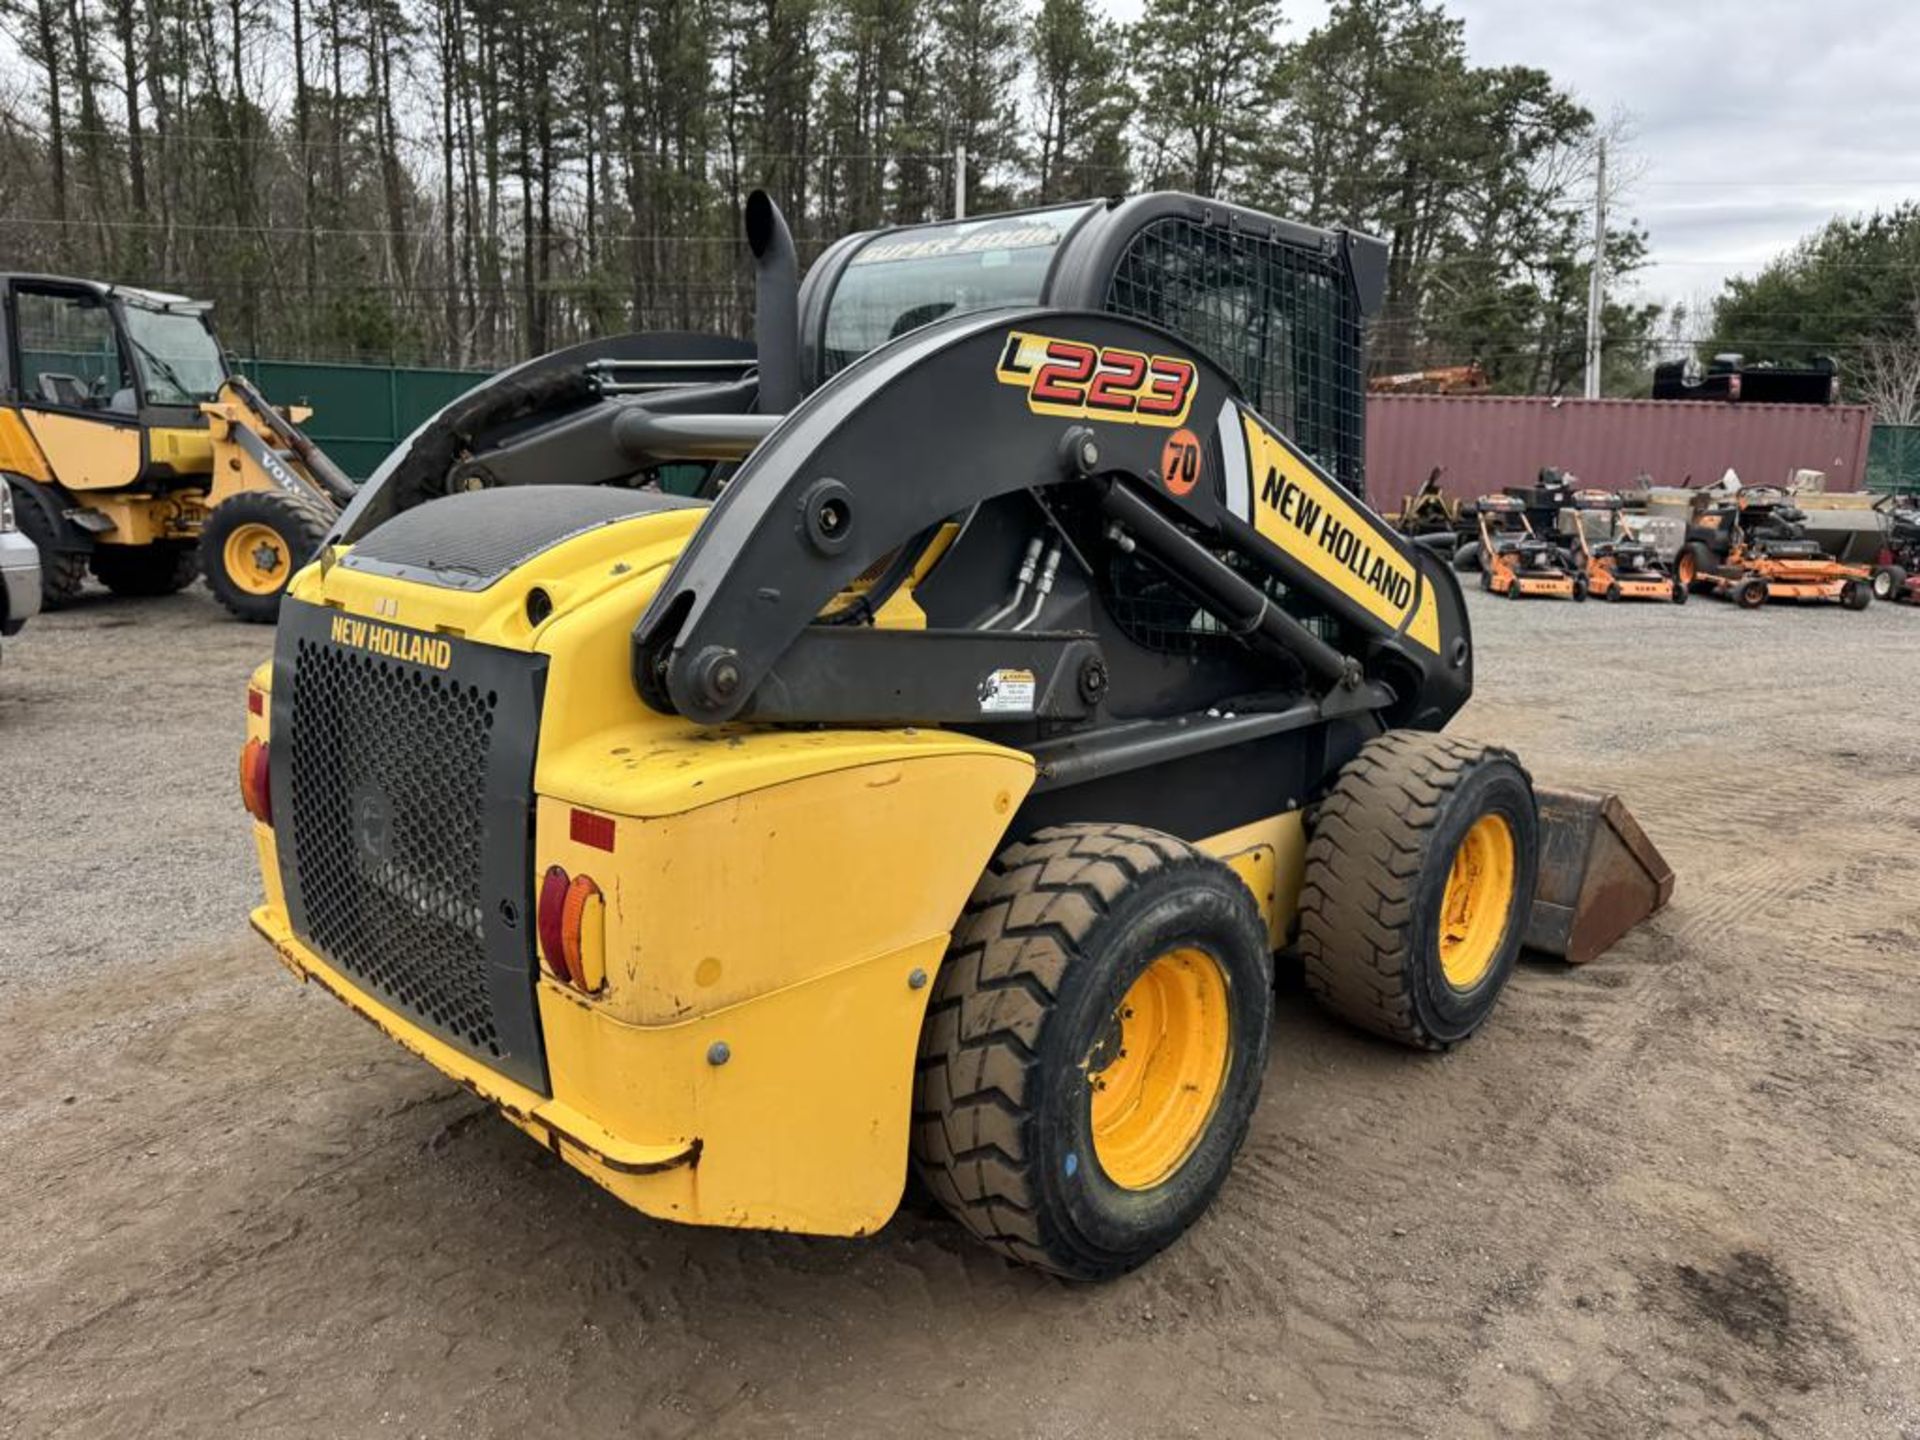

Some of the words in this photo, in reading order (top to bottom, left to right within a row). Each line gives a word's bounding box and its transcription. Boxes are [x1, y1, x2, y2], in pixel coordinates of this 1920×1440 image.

[1001, 337, 1194, 417] L223
[1166, 442, 1198, 483] 70
[1260, 465, 1322, 537] NEW
[1318, 514, 1412, 610] HOLLAND
[330, 615, 367, 649] NEW
[368, 625, 452, 671] HOLLAND
